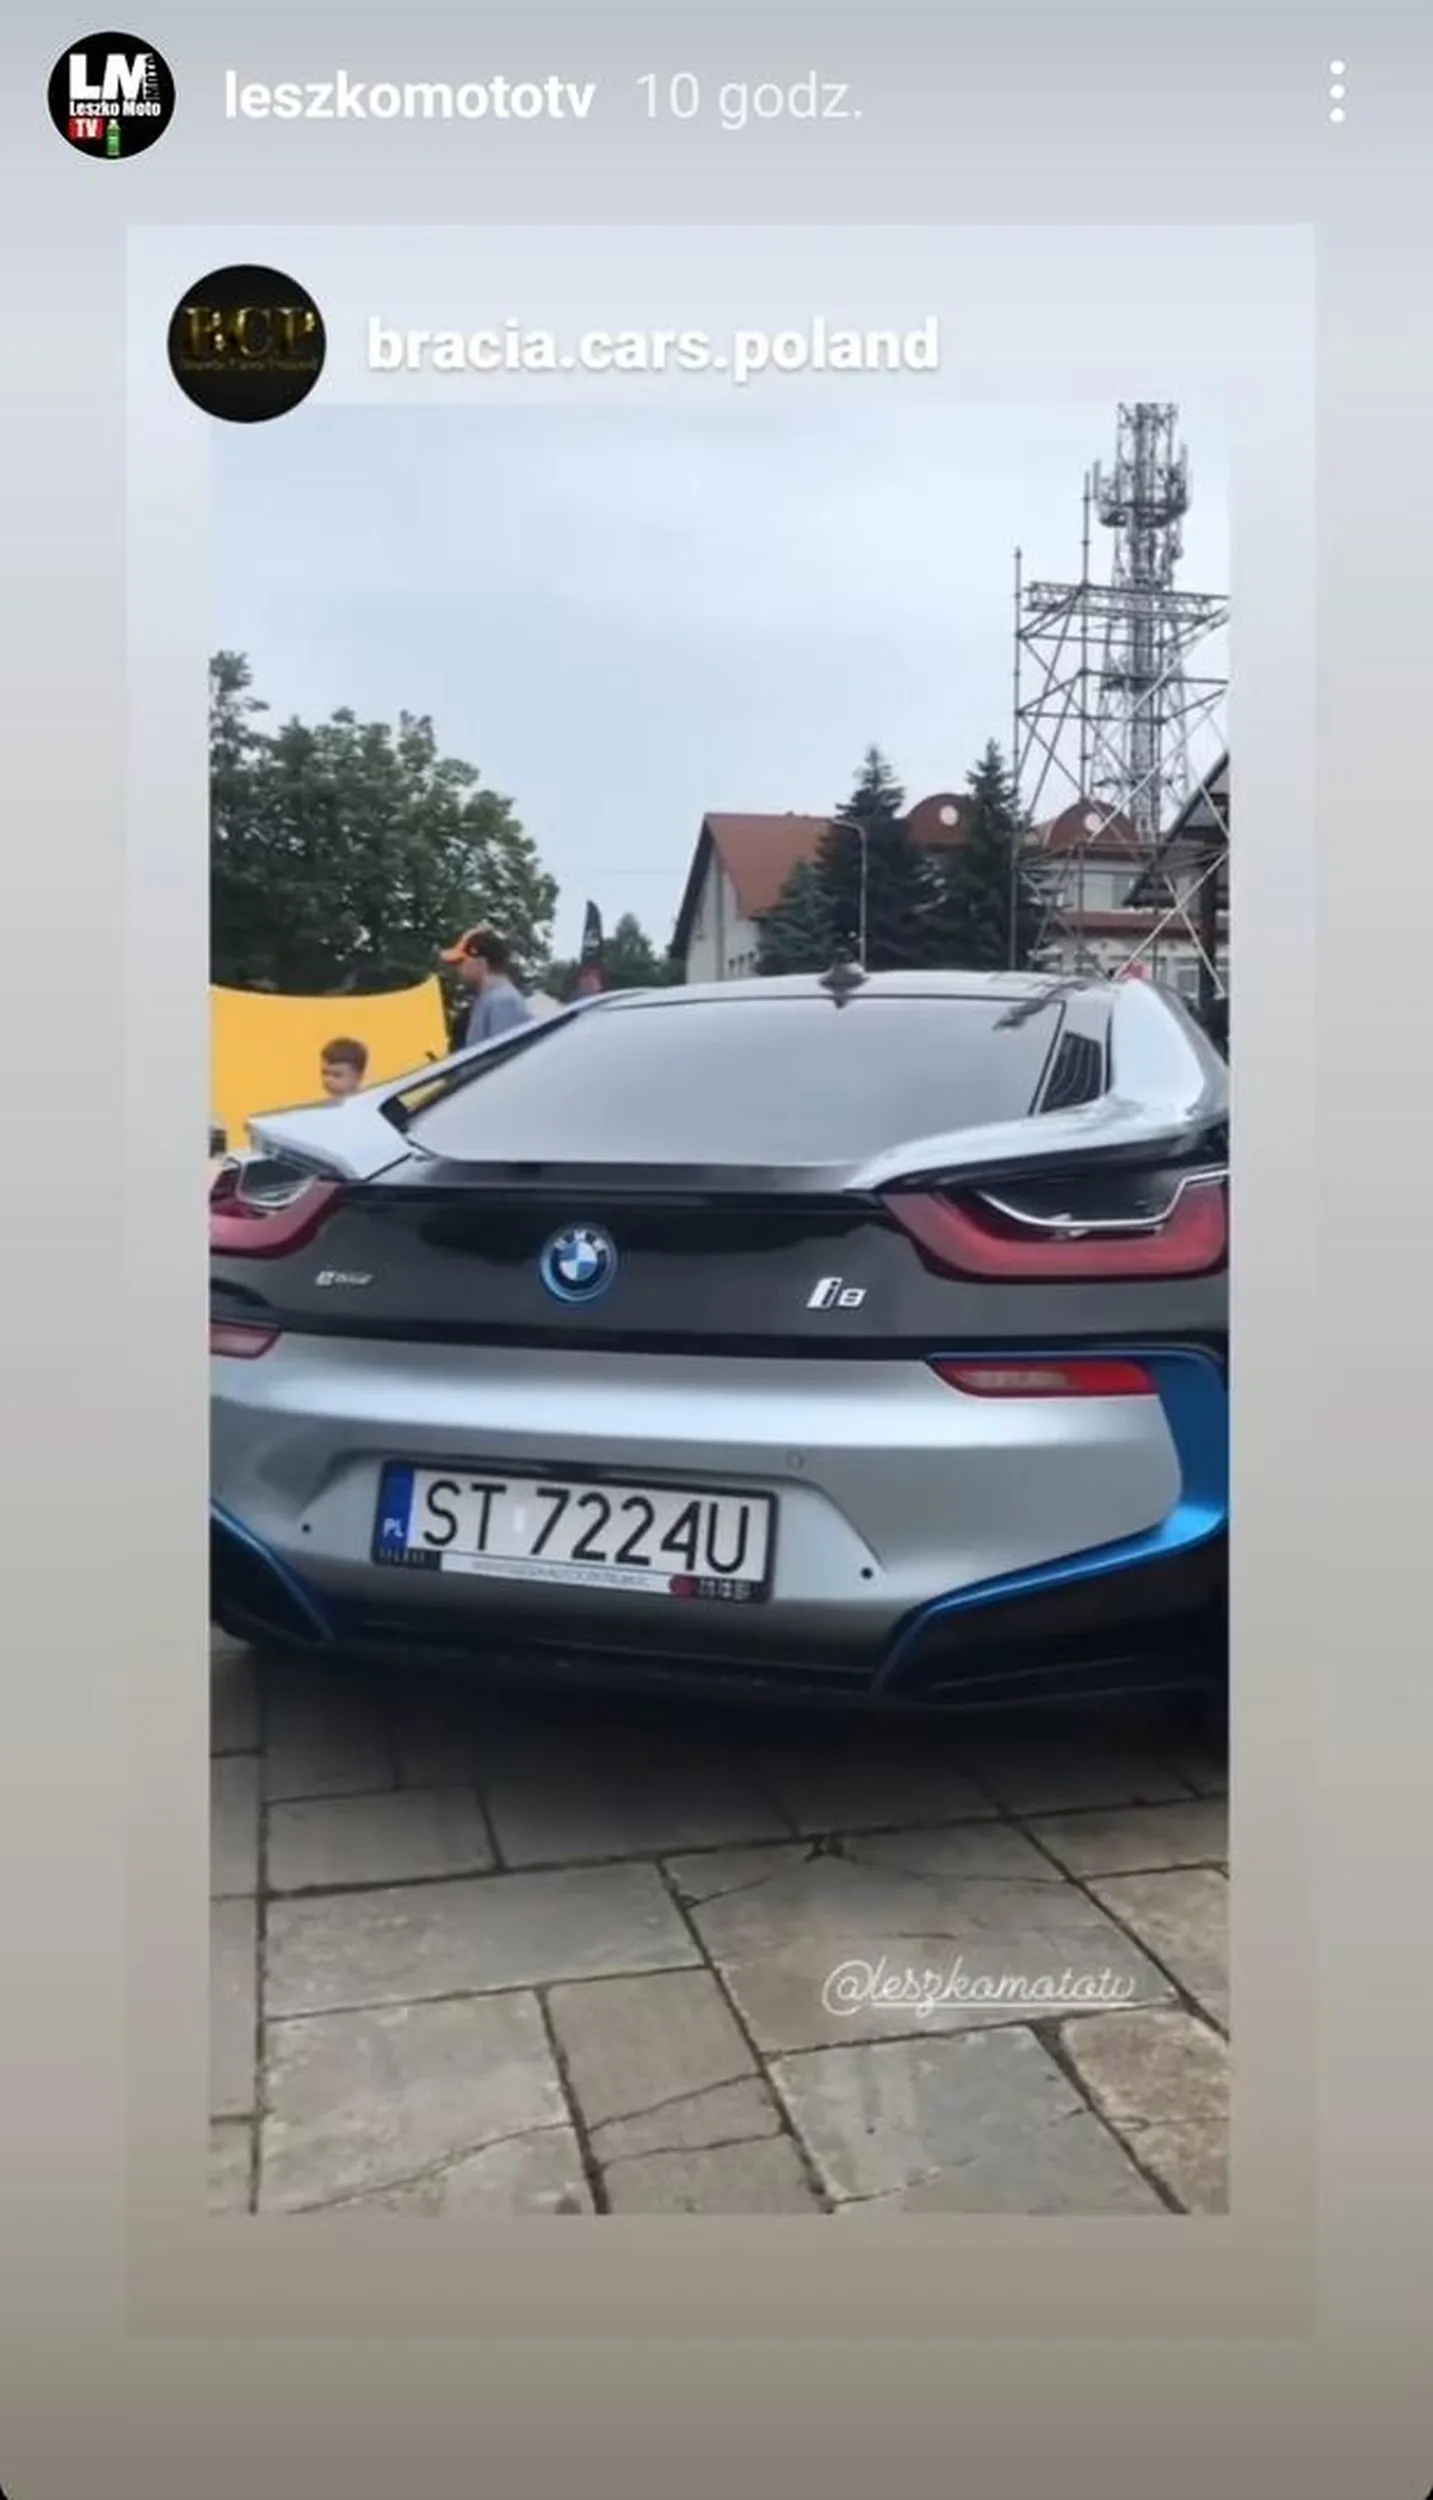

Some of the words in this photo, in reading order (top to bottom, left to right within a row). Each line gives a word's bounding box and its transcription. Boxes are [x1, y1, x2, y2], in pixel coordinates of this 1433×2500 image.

[383, 1518, 405, 1538] PL
[423, 1479, 507, 1552] ST
[531, 1487, 750, 1574] 7224U
